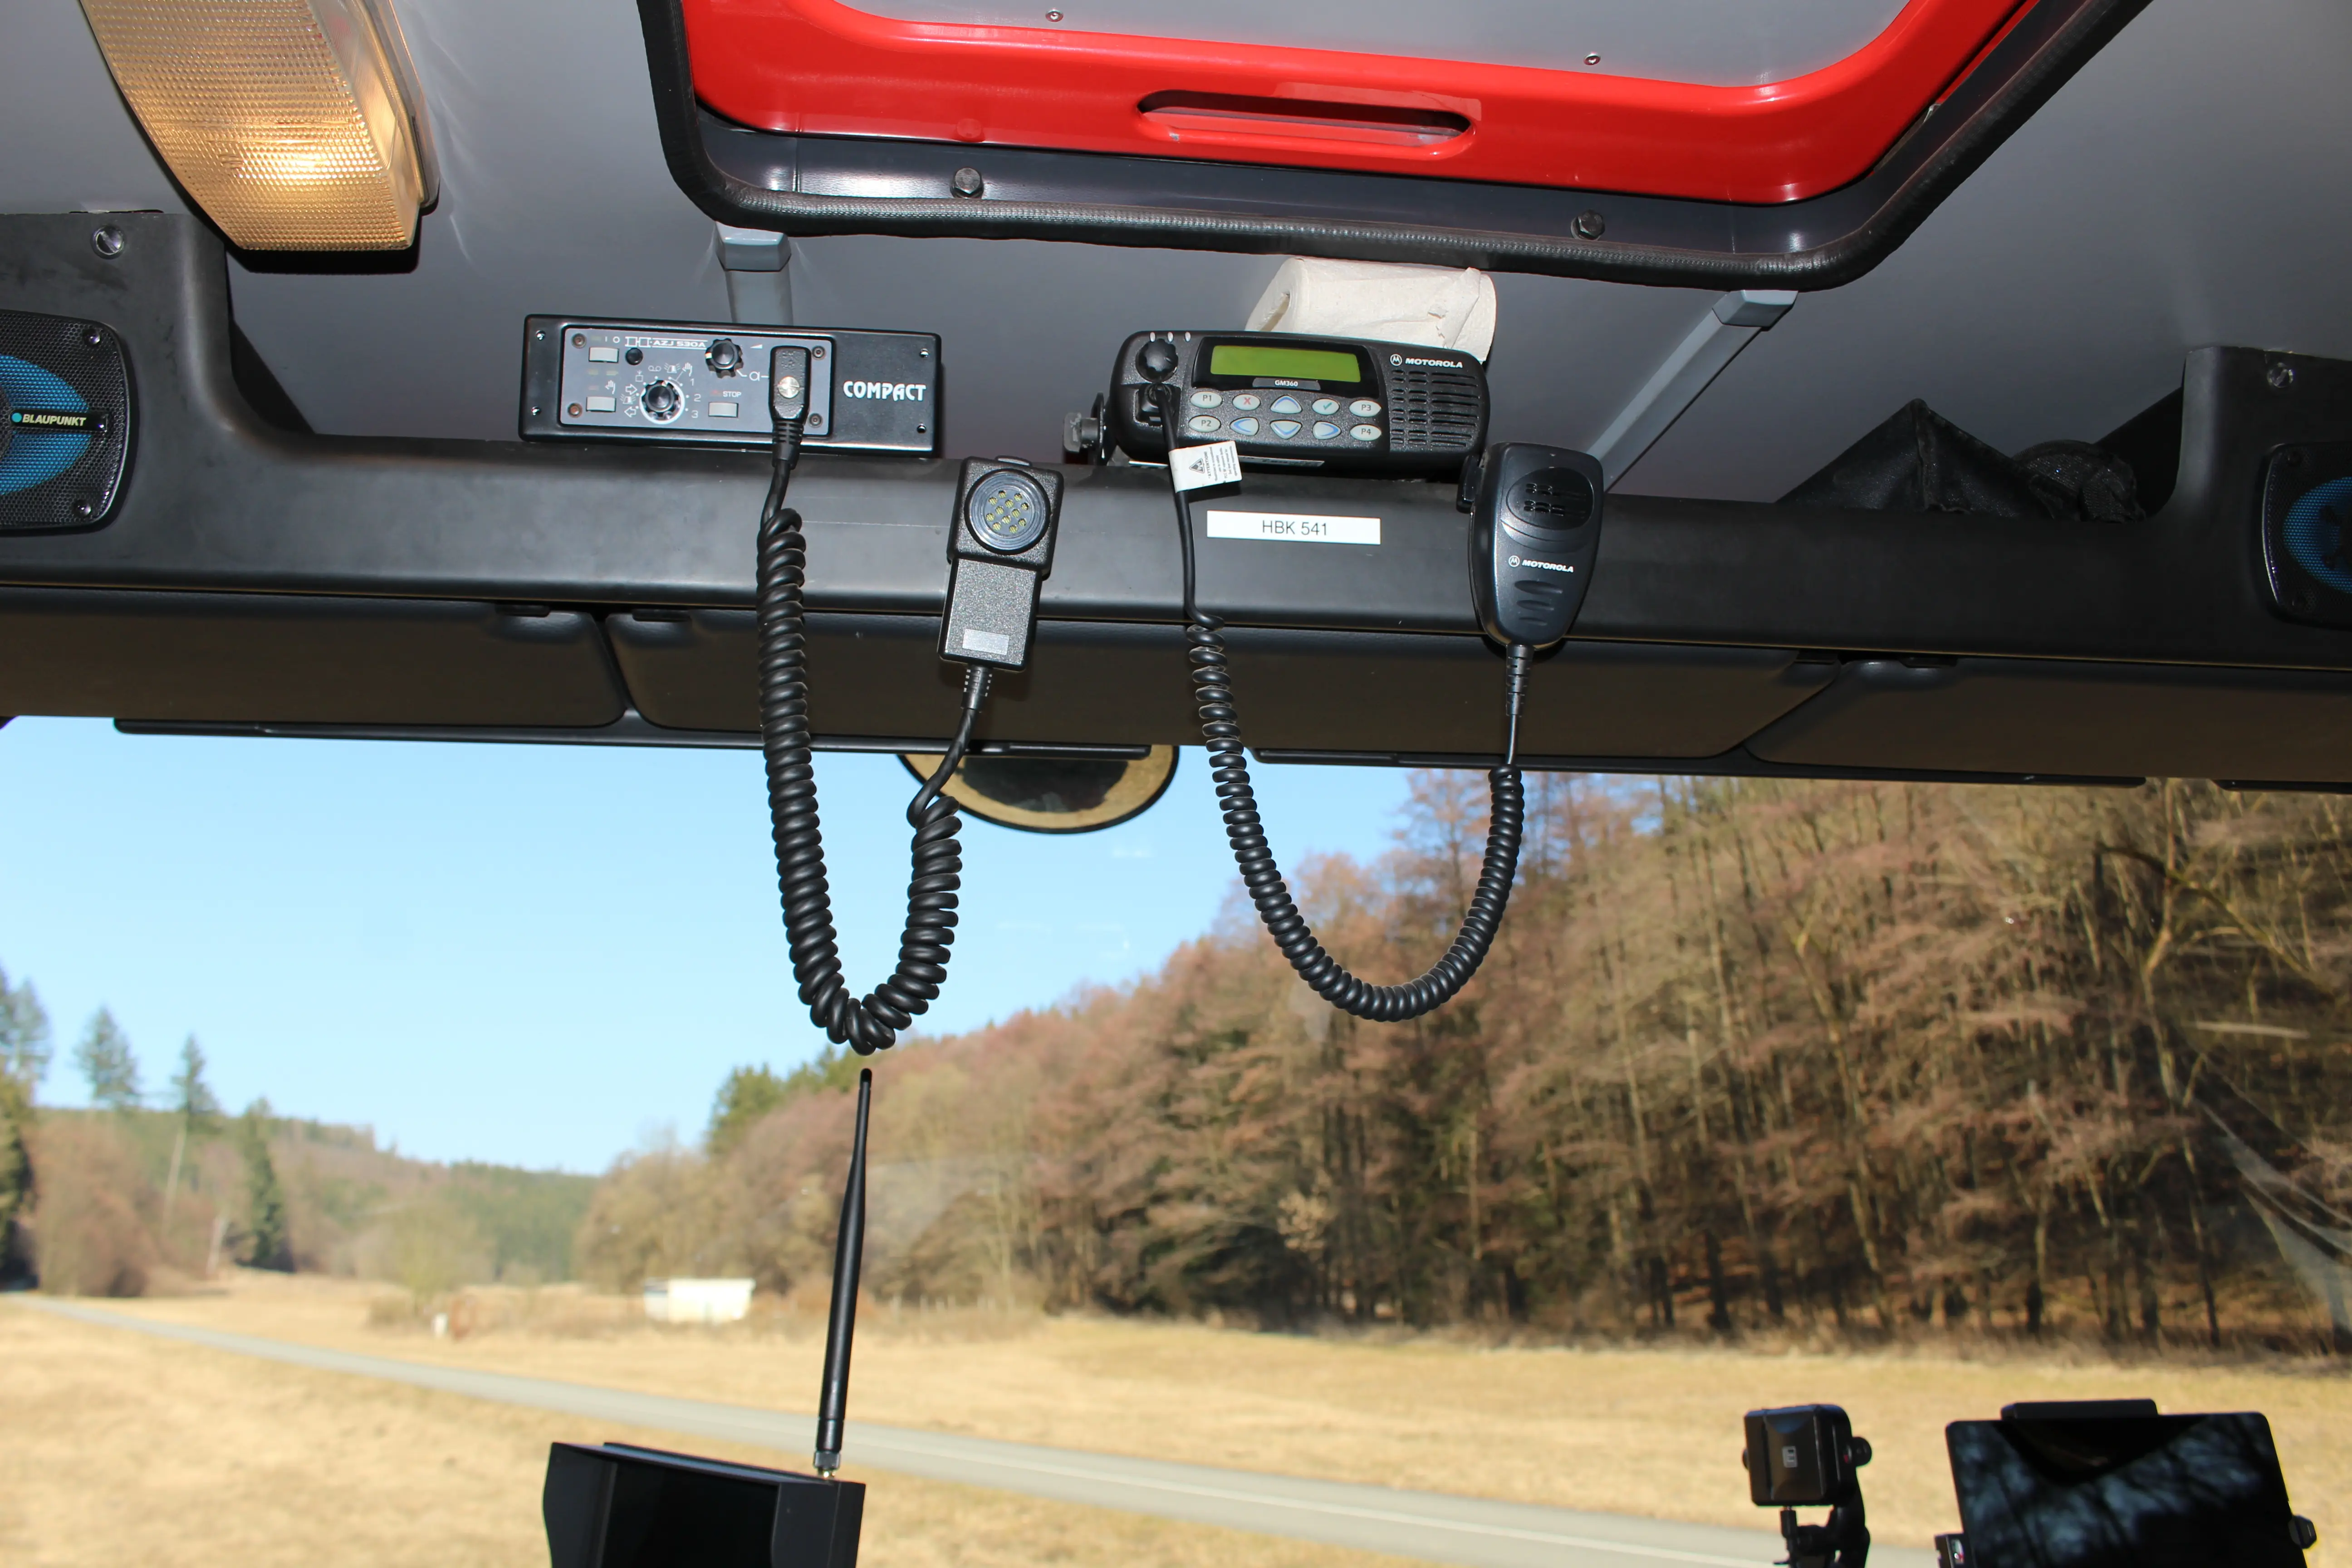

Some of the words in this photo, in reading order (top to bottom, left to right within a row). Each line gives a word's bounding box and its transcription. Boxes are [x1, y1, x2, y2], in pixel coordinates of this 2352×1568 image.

[1405, 358, 1463, 368] MOTOROLA
[690, 378, 695, 386] 1
[843, 380, 927, 402] COMPACT
[694, 393, 701, 402] 2
[22, 413, 87, 426] BLAUPUNKT
[691, 410, 699, 418] 3
[1262, 519, 1295, 535] HBK
[1301, 522, 1327, 535] 541
[1521, 559, 1574, 573] MOTOROLA
